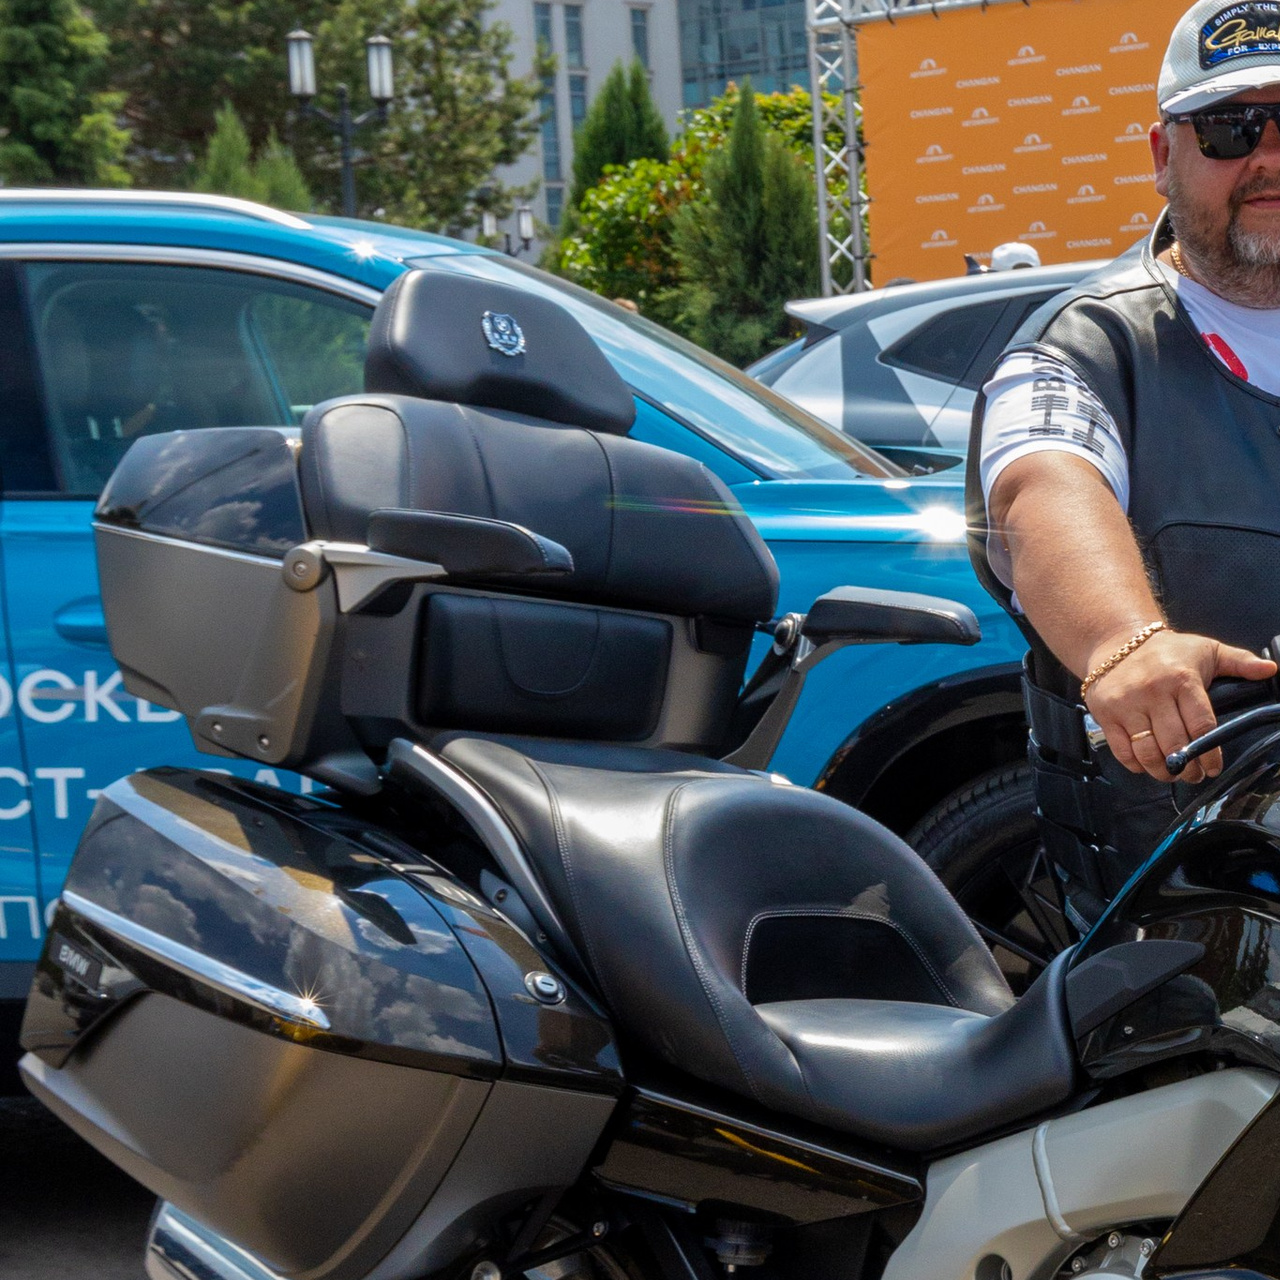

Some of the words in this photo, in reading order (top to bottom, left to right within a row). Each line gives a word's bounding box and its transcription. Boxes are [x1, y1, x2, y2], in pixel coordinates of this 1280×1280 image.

[1214, 4, 1249, 26] SIMPLY
[1256, 3, 1278, 12] THE
[1227, 44, 1248, 55] FOR
[58, 944, 91, 976] BMW
